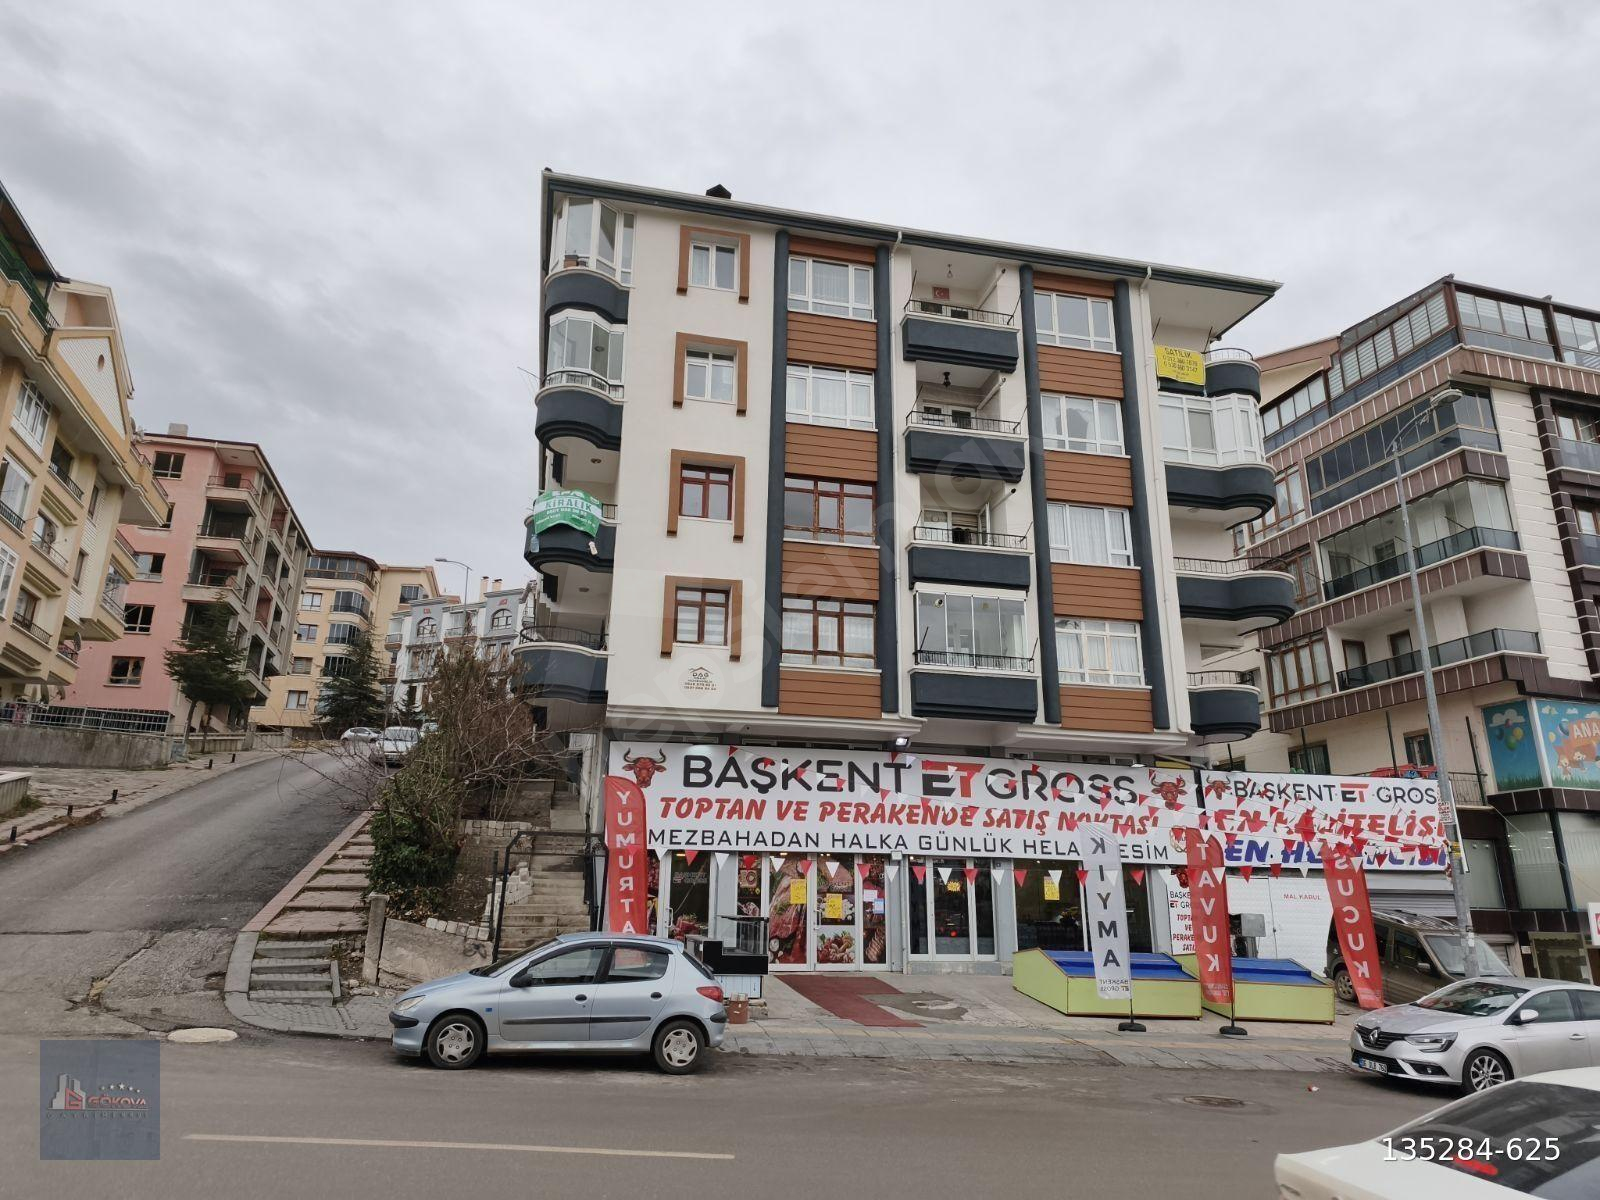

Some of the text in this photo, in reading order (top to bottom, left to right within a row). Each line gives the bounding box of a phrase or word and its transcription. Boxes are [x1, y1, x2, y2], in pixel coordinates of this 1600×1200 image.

[683, 755, 1139, 805] BAŞKENT ET GROSS
[1340, 783, 1369, 803] ET
[1376, 786, 1437, 805] GROS
[659, 796, 767, 821] TOPTAN
[776, 800, 809, 822] VE
[818, 802, 974, 827] PERAKENDE
[982, 807, 1050, 836] SATIŞ
[648, 829, 1168, 860] MEZBAHADAN HALKA GÜNLÜK HELA ESİM
[1224, 839, 1270, 863] EN
